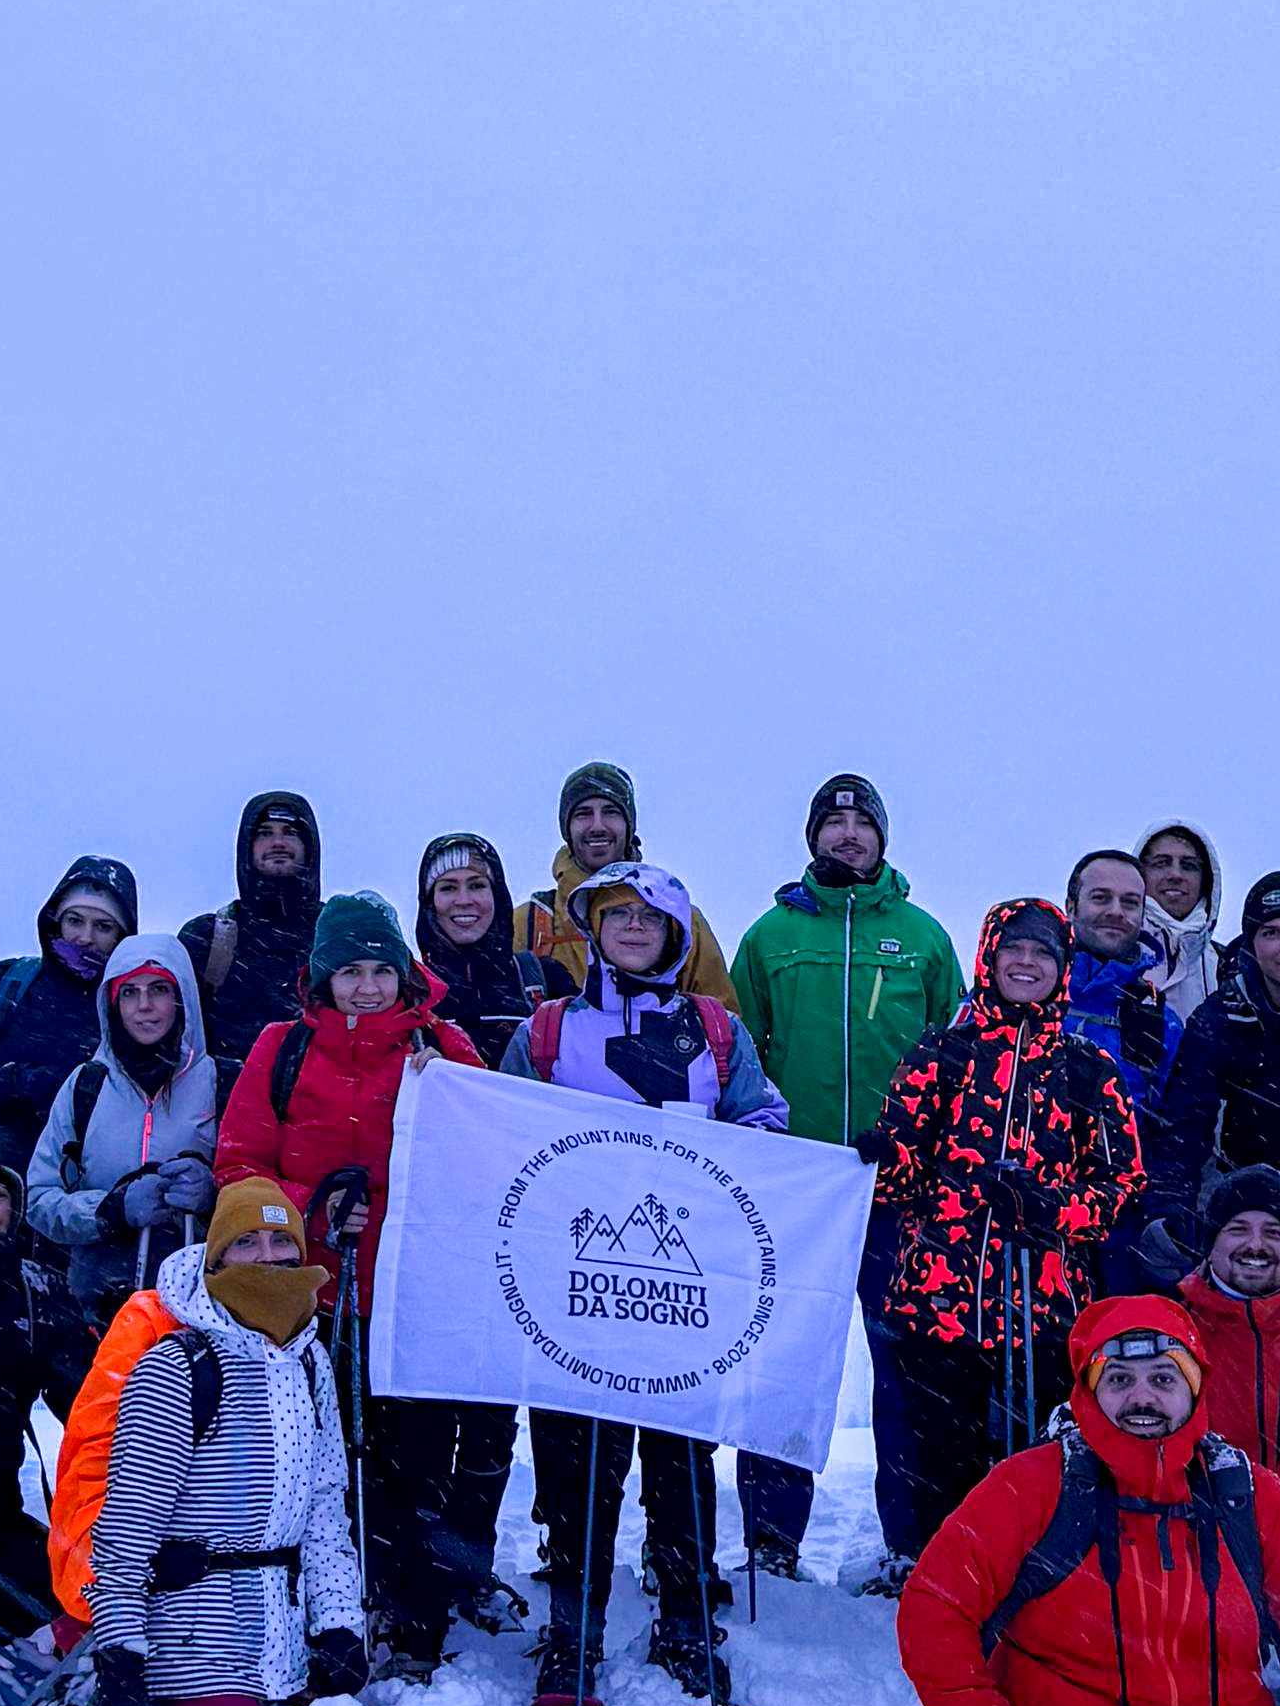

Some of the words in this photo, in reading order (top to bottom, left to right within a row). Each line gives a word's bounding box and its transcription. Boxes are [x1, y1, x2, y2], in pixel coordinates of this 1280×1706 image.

[549, 1129, 659, 1157] MOUNTAINS,
[662, 1139, 699, 1164] FOR
[519, 1149, 555, 1178] THE
[701, 1156, 735, 1188] THE
[498, 1177, 528, 1228] FROM
[729, 1185, 777, 1291] MOUNTAINS,
[567, 1270, 708, 1308] DOLOMITI
[494, 1250, 703, 1396] WWW.DOLOMITIDASOGNO.IT
[567, 1293, 610, 1319] DA
[614, 1297, 710, 1330] SOGNO
[741, 1294, 775, 1344] SINCE
[711, 1338, 750, 1376] 2018
